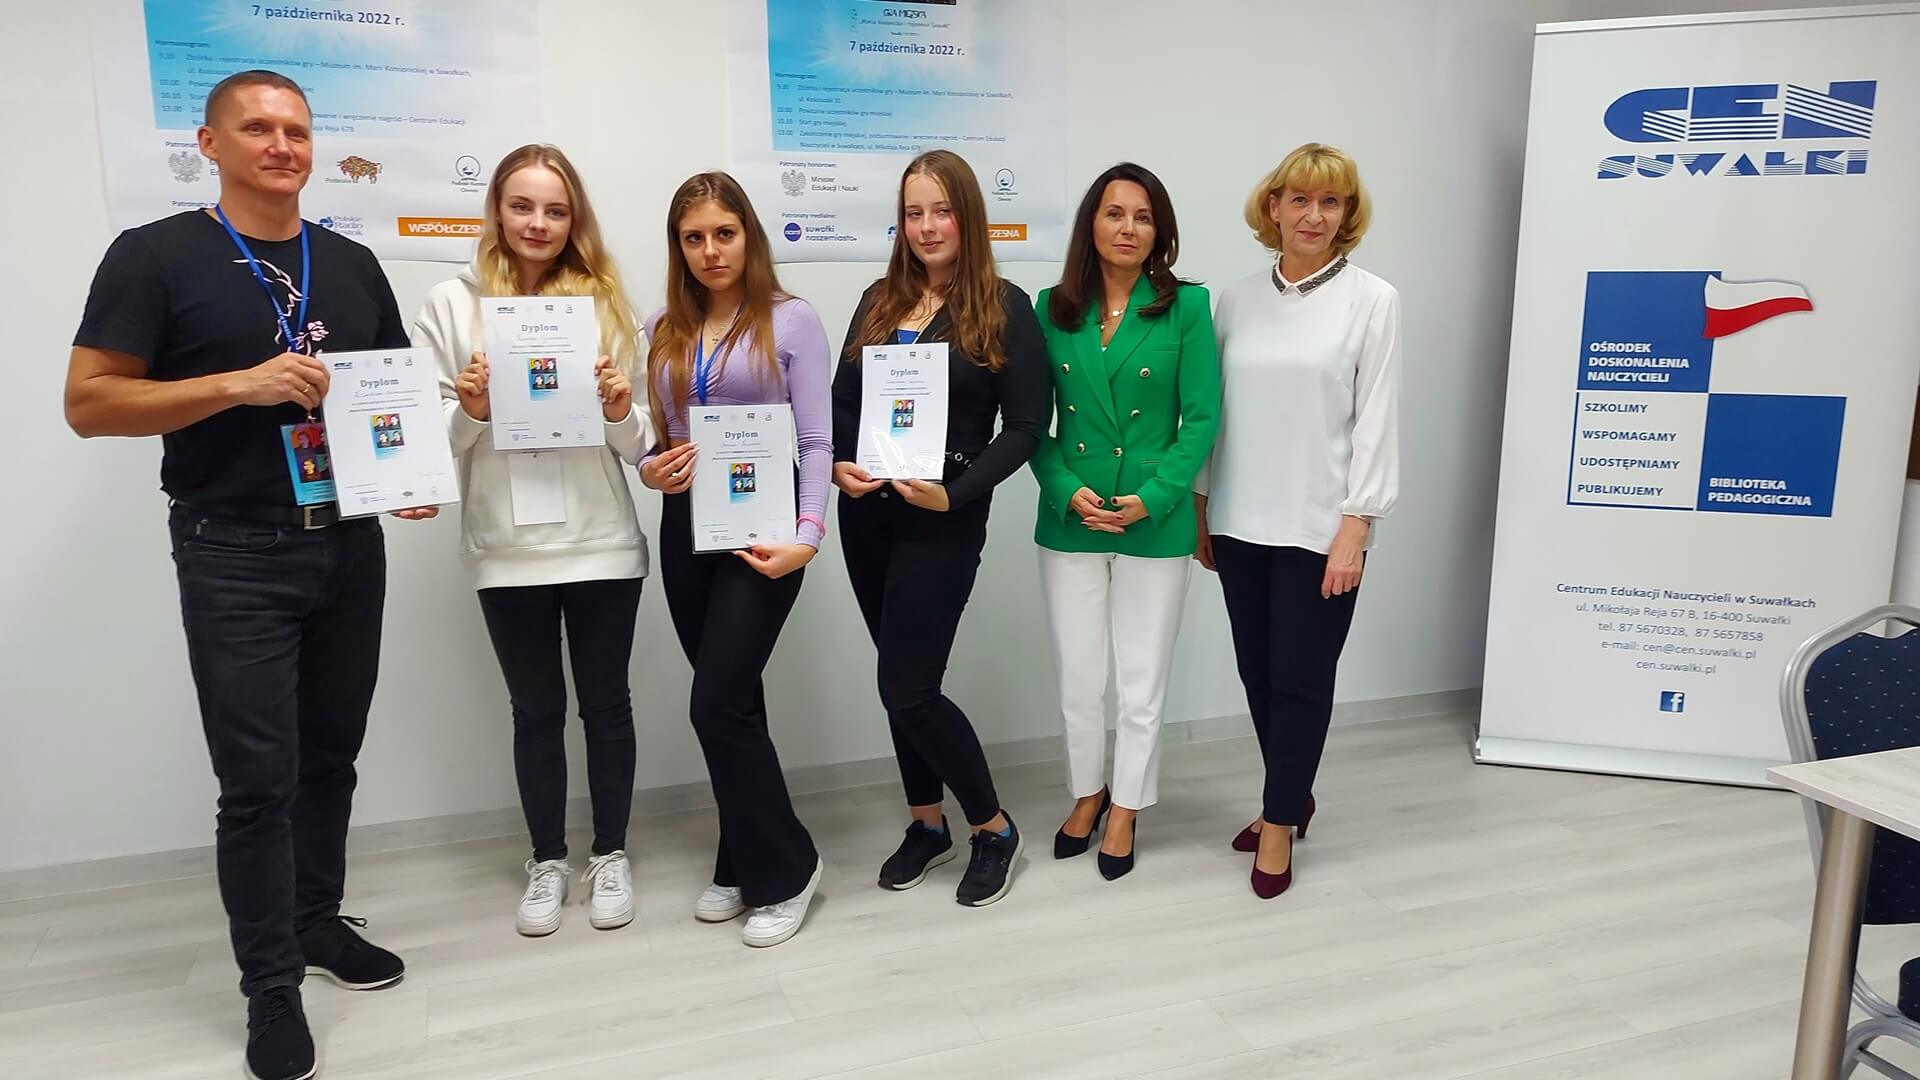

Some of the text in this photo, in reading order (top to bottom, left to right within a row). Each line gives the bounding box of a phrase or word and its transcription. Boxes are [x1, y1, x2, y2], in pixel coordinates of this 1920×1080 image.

[252, 4, 405, 26] 7 października 2022 r.
[850, 40, 965, 56] 7 października 2022 r.
[1603, 80, 1877, 143] CEN
[1597, 150, 1869, 179] SUWAŁKI
[521, 323, 559, 333] Dyplom
[1589, 341, 1652, 353] OŚRODEK
[1588, 356, 1690, 369] DOSKONALENIA
[890, 368, 919, 378] Dyplom
[1586, 371, 1671, 383] NAUCZYCIELI
[360, 377, 400, 389] Dyplom
[1584, 403, 1648, 413] SZKOLIMY
[724, 430, 759, 441] Dyplom
[1582, 430, 1677, 442] WSPOMAGAMY
[1580, 457, 1681, 470] UDOSTĘPNIAMY
[1577, 484, 1664, 496] PUBLIKUJEMY
[1709, 477, 1787, 490] BIBLIOTEKA
[1707, 492, 1812, 506] PEDAGOGICZNA
[1556, 583, 1816, 609] Centrum Edukacji Nauczycieli w Suwałkach
[1576, 603, 1590, 612] ul.
[1592, 604, 1640, 616] Mikołaja
[1643, 607, 1668, 618] Reja
[1670, 608, 1685, 618] 67
[1703, 610, 1744, 622] 16-400
[1746, 613, 1792, 625] Suwałki
[1598, 622, 1764, 641] tel. 87 5670328, 87 5657858
[1601, 640, 1757, 659] e-mail: cen@cen.suwalki.pl
[1636, 661, 1716, 674] cen.suwalki.pl
